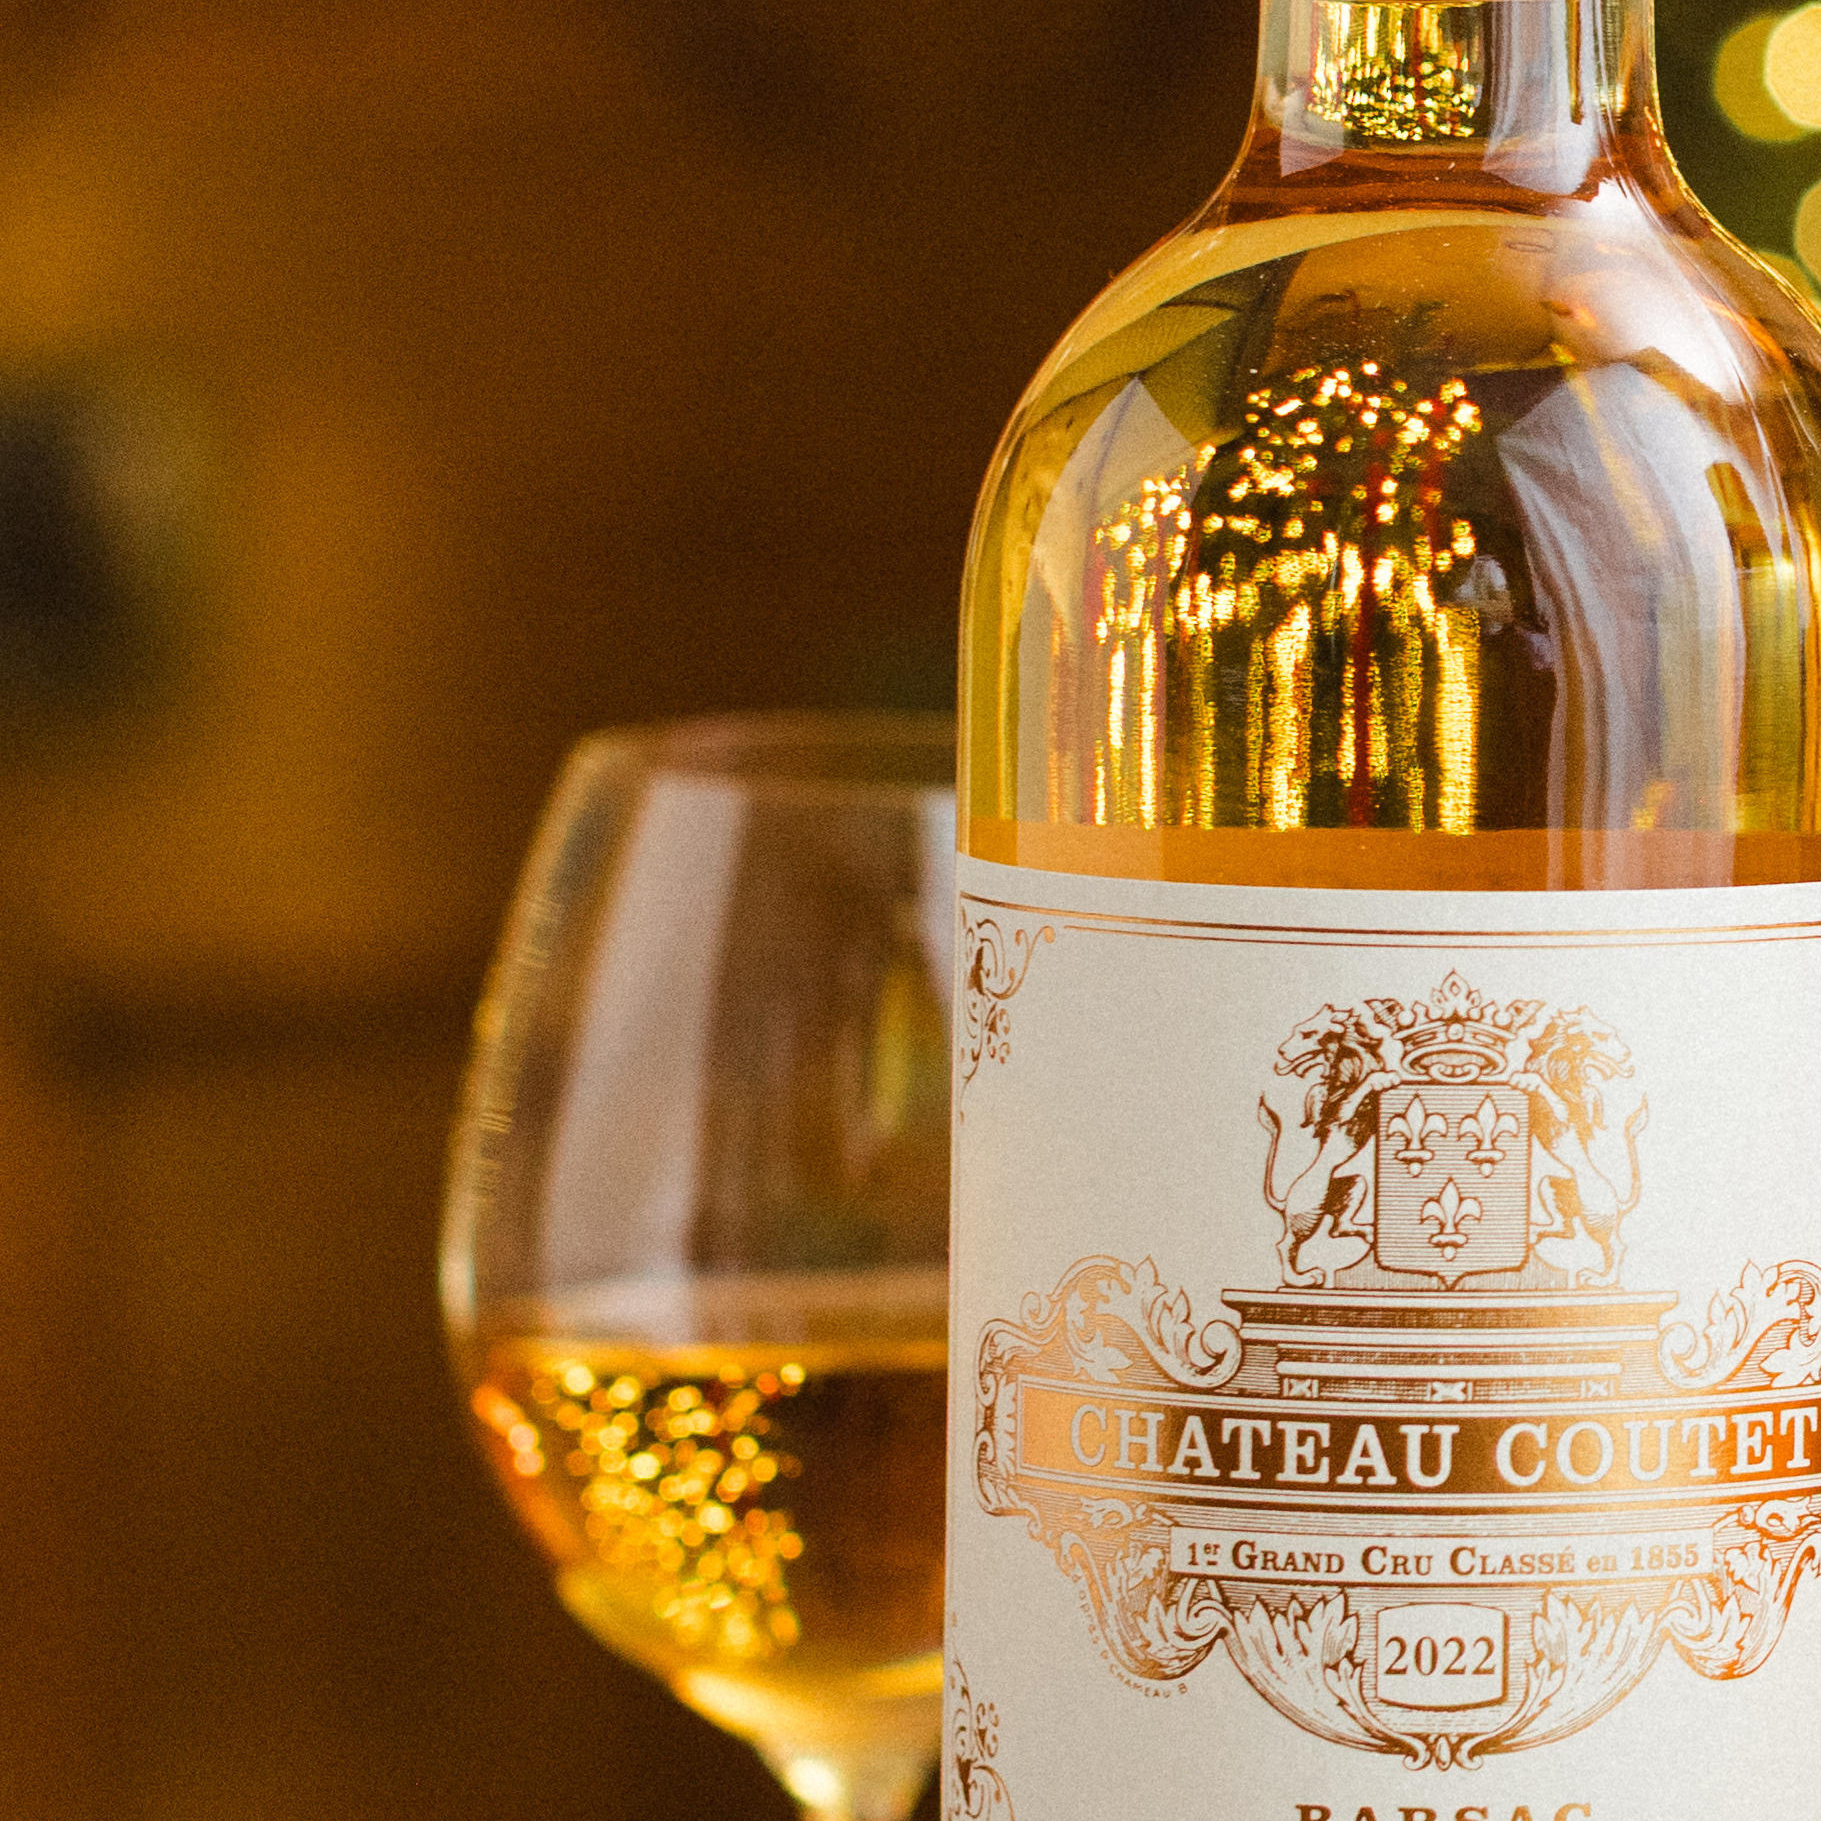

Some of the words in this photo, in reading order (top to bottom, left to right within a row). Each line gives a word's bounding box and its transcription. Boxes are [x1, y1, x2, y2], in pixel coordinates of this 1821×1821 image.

[1069, 1403, 1461, 1489] CHATEAU
[1494, 1406, 1820, 1486] COUTET
[1230, 1539, 1345, 1574] GRAND
[1359, 1544, 1433, 1576] CRU
[1448, 1544, 1576, 1576] CLASSÉ
[1586, 1555, 1618, 1573] en
[1629, 1540, 1700, 1571] 1855
[1383, 1635, 1497, 1677] 2022
